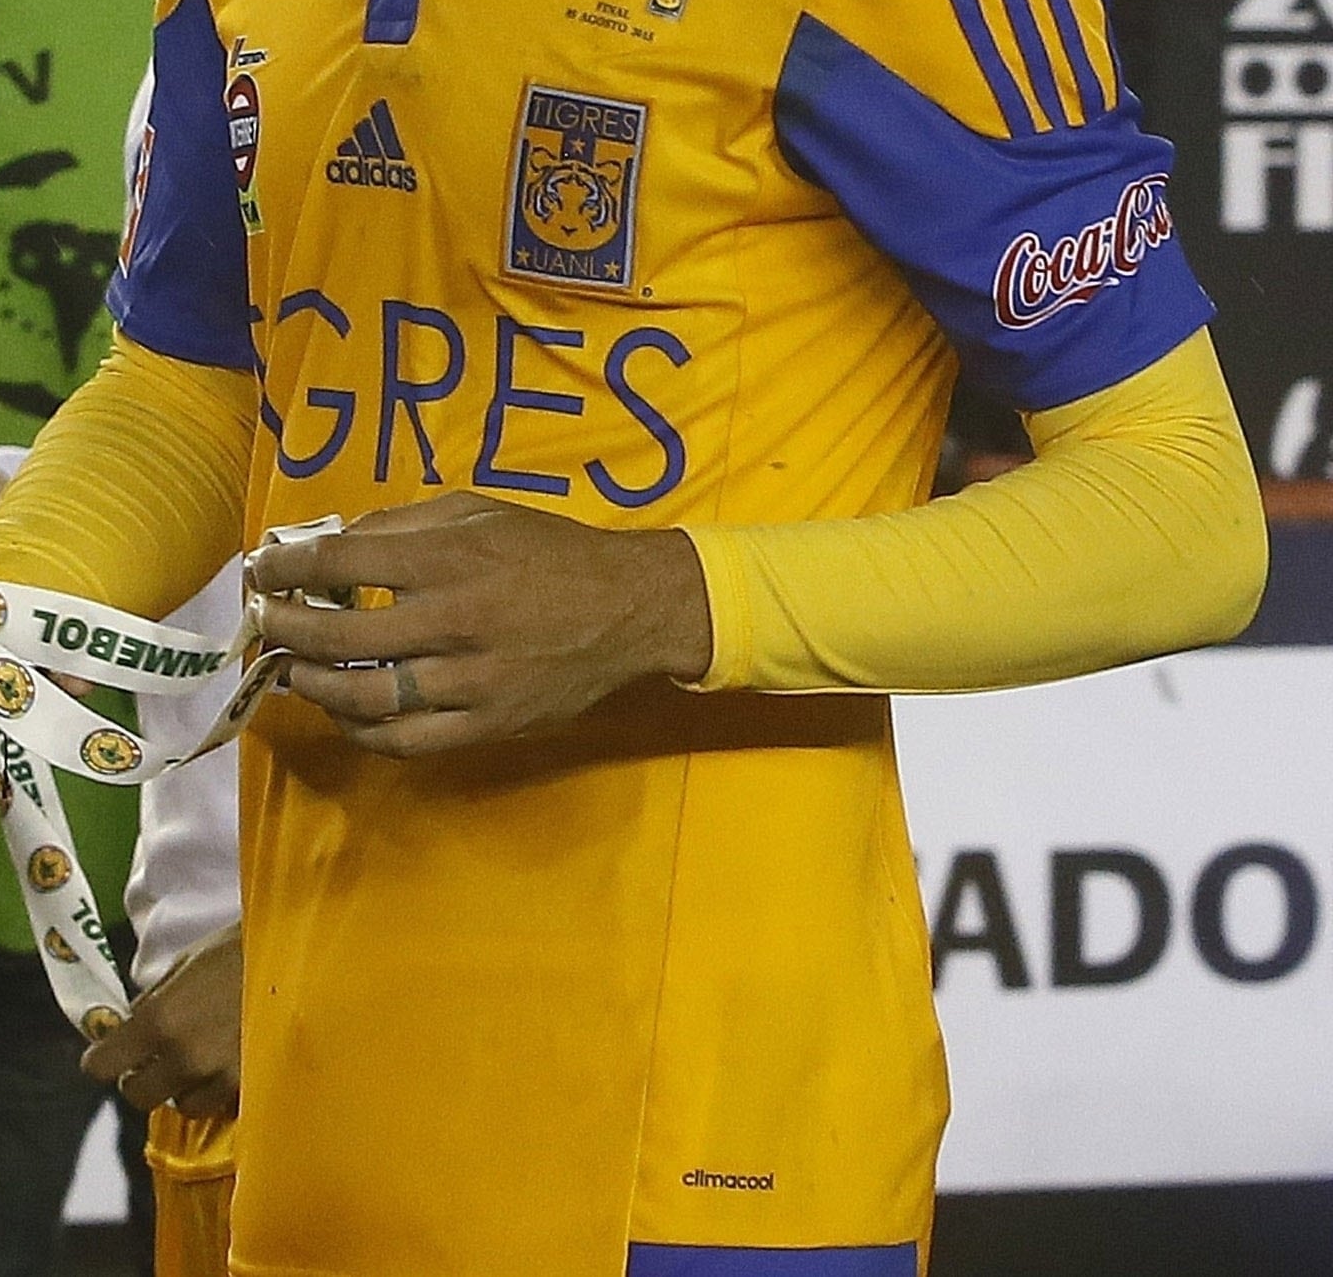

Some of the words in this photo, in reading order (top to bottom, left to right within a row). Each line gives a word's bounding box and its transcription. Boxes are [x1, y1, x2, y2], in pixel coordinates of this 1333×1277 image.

[533, 97, 638, 140] TIGRES
[326, 159, 418, 193] adidas
[534, 252, 602, 278] UANL
[682, 1169, 775, 1191] climacool
